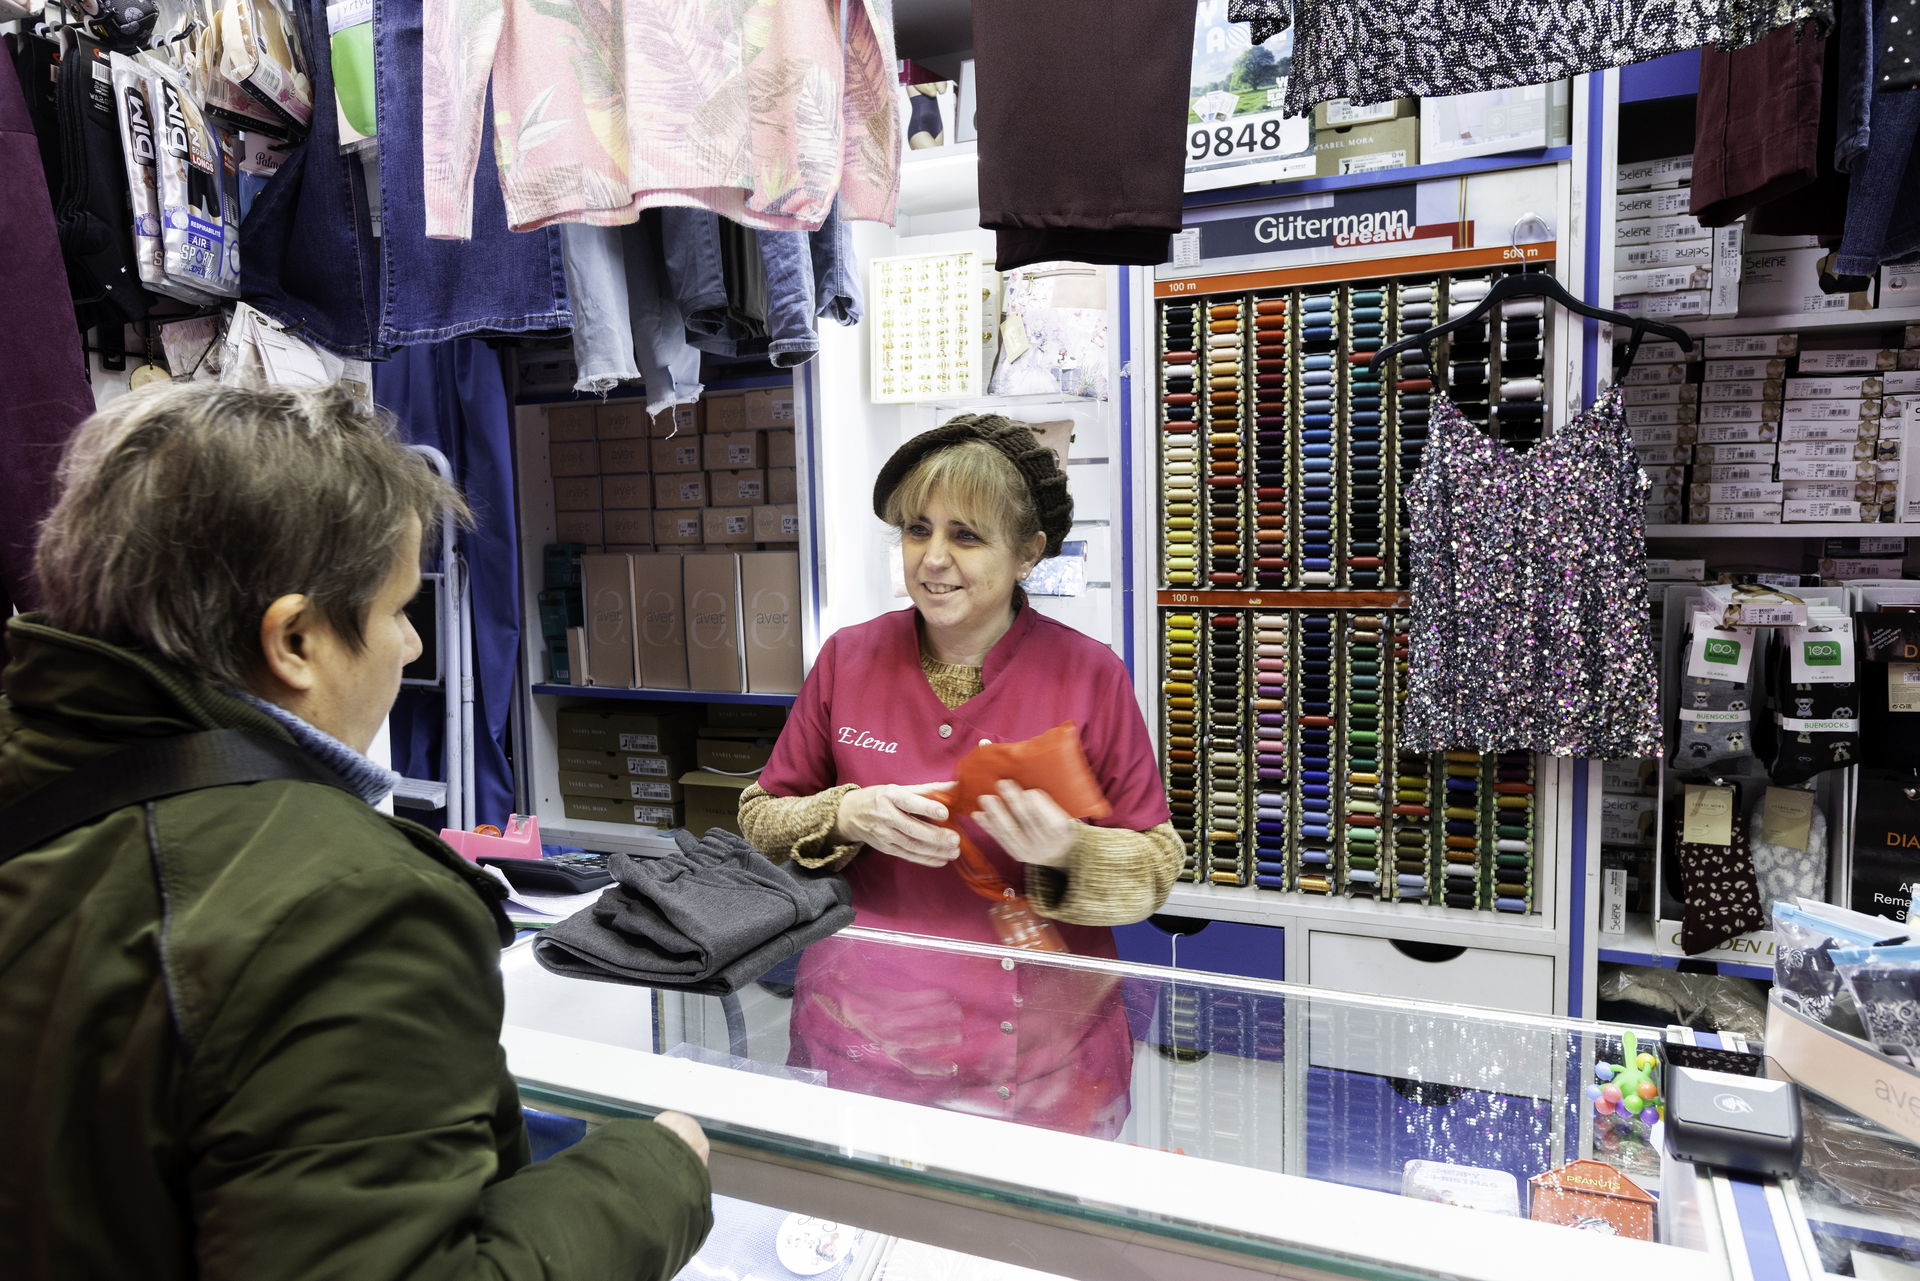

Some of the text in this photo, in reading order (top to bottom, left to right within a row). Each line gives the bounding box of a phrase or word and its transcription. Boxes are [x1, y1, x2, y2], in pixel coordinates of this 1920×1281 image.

[166, 87, 188, 153] DIM
[129, 95, 154, 160] DIM
[189, 127, 200, 147] 2
[1348, 137, 1374, 146] MORA
[192, 154, 214, 173] LONGS
[1619, 167, 1652, 180] Selene
[1619, 199, 1652, 212] Selene
[190, 220, 222, 238] RESPIRABILITÉ
[1254, 209, 1408, 244] Gütermann
[1618, 227, 1651, 238] Selene
[192, 236, 207, 248] AIR
[1335, 223, 1416, 247] creativ
[180, 244, 215, 268] SPORT
[1527, 248, 1538, 257] m
[1745, 256, 1787, 270] Selene
[1618, 274, 1638, 282] Selene
[1169, 282, 1184, 292] 100
[1172, 593, 1199, 602] 100 m
[596, 609, 622, 622] avet
[647, 610, 674, 623] avet
[695, 611, 725, 625] avet
[756, 611, 789, 625] avet
[1708, 652, 1735, 660] BUENSOCKS
[837, 726, 898, 754] Elena
[1602, 797, 1639, 811] Selene
[1610, 904, 1621, 931] Selene
[1567, 1175, 1622, 1190] PEANUTS
